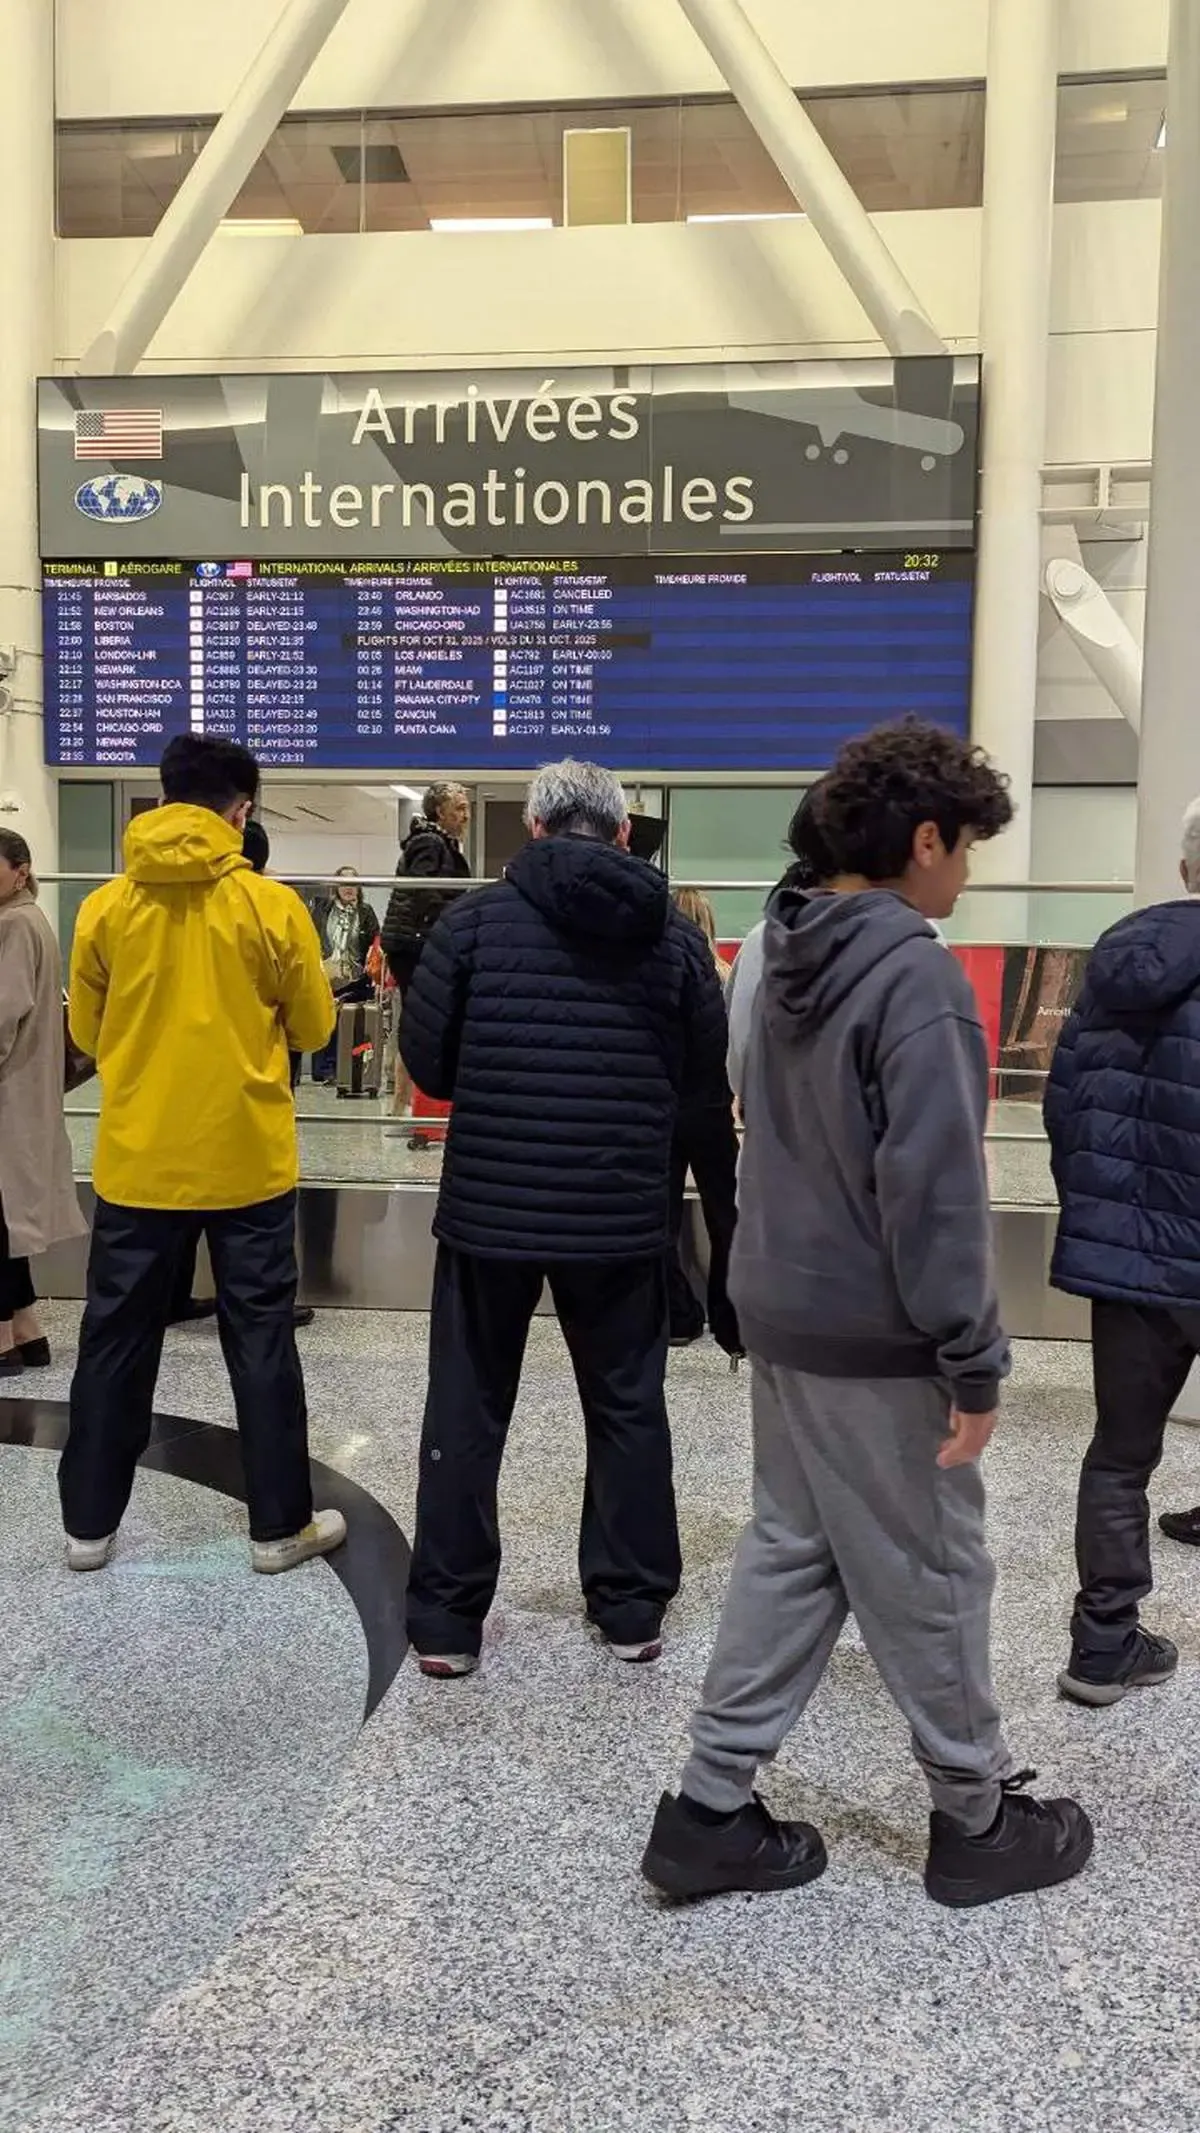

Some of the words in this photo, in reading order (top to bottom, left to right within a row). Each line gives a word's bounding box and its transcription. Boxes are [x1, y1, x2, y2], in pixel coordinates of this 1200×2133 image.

[351, 379, 640, 445] Arrivées
[239, 465, 755, 528] Internationales
[903, 554, 939, 568] 20:32
[44, 563, 99, 574] TERMINAL
[119, 562, 183, 575] AÉROGARE
[259, 562, 346, 574] INTERNATIONAL
[349, 562, 405, 573] ARRIVALS
[413, 560, 470, 573] ARRIVÉES
[473, 560, 579, 573] INTERNATIONALES
[94, 591, 147, 601] BARBADOS
[246, 591, 305, 601] EARLY-21:12
[395, 591, 444, 600] ORLANDO
[552, 589, 613, 599] CANCELLED
[94, 606, 117, 616] NEW
[119, 606, 165, 616] ORLEANS
[246, 605, 305, 616] EARLY-21:15
[394, 605, 480, 615] WASHINGTON-IAD
[552, 604, 568, 614] ON
[570, 604, 594, 614] TIME
[94, 620, 134, 631] BOSTON
[395, 620, 465, 630] CHICAGO-ORD
[94, 635, 132, 646] LIBERIA
[357, 636, 398, 646] FLIGHTS
[399, 636, 420, 646] FOR
[422, 636, 443, 645] OCT
[491, 635, 517, 645] VOLS
[520, 635, 534, 644] DU
[536, 635, 547, 644] 31
[574, 635, 597, 645] 2025
[94, 650, 157, 660] LONDON-LHR
[395, 651, 414, 660] LOS
[416, 651, 463, 661] ANGELES
[94, 664, 136, 675] NEWARK
[394, 665, 423, 674] MIAMI
[552, 664, 567, 674] ON
[570, 664, 593, 674] TIME
[59, 679, 83, 689] 22:17
[95, 679, 183, 689] WASHINGTON-DCA
[395, 680, 408, 689] FT
[410, 680, 474, 690] LAUDERDALE
[552, 679, 567, 689] ON
[570, 679, 593, 689] TIME
[95, 694, 115, 704] SAN
[117, 694, 173, 704] FRANCISCO
[357, 695, 382, 704] 01:15
[395, 695, 435, 704] PANAMA
[437, 694, 481, 705] CITY-PTY
[552, 694, 567, 704] ON
[570, 694, 593, 704] TIME
[95, 708, 161, 718] HOUSTON-IAH
[394, 709, 437, 719] CANCUN
[551, 709, 567, 719] ON
[570, 709, 593, 719] TIME
[96, 722, 164, 733] CHICAGO-ORD
[357, 724, 382, 733] 02:10
[395, 724, 428, 734] PUNTA
[429, 724, 457, 734] CANA
[96, 737, 137, 747] NEWARK
[95, 751, 136, 761] BOGOTA
[254, 752, 305, 763] ARLY-23:33
